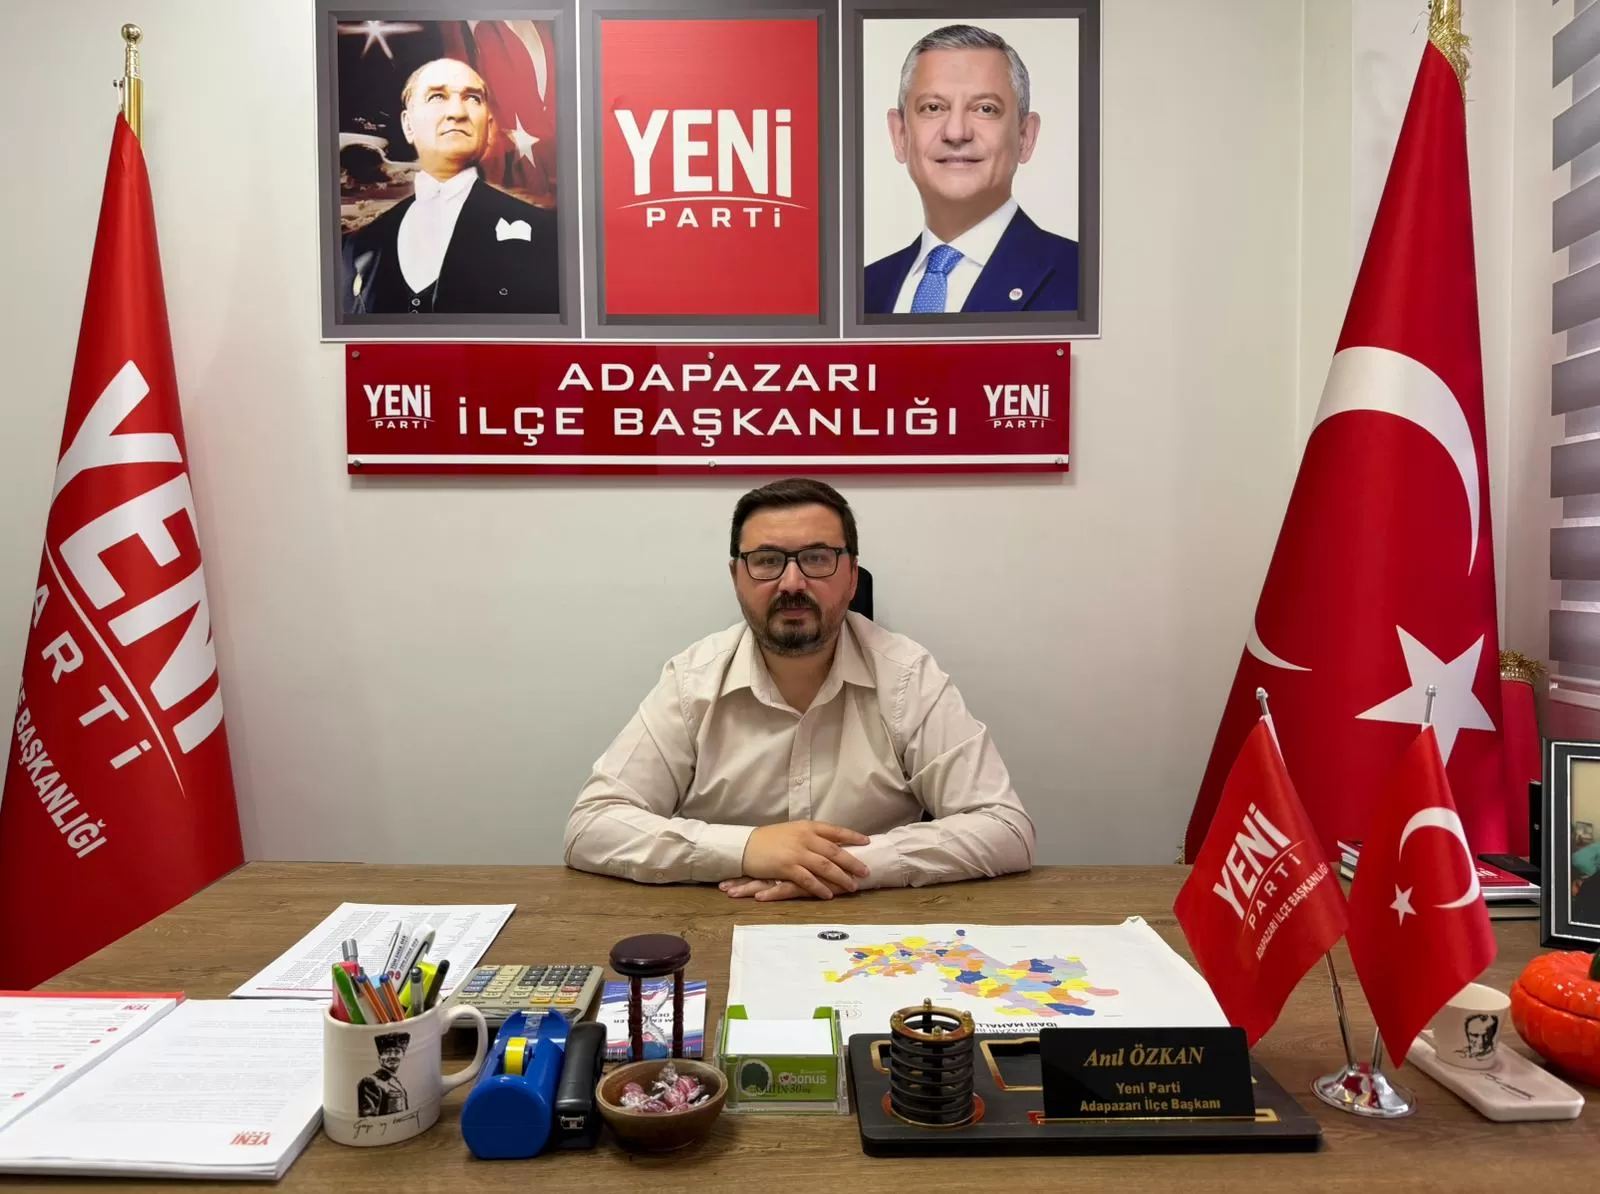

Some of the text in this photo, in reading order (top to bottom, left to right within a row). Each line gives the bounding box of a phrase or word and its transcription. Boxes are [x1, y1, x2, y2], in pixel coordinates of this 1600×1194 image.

[557, 362, 877, 393] ADAPAZARI
[458, 396, 957, 448] İLÇE BAŞKANLIĞI
[16, 707, 107, 859] BAŞKANLIĞI
[1129, 1043, 1205, 1066] ÖZKAN
[1115, 1081, 1181, 1095] Yeni Parti
[1144, 1096, 1169, 1112] İlçe
